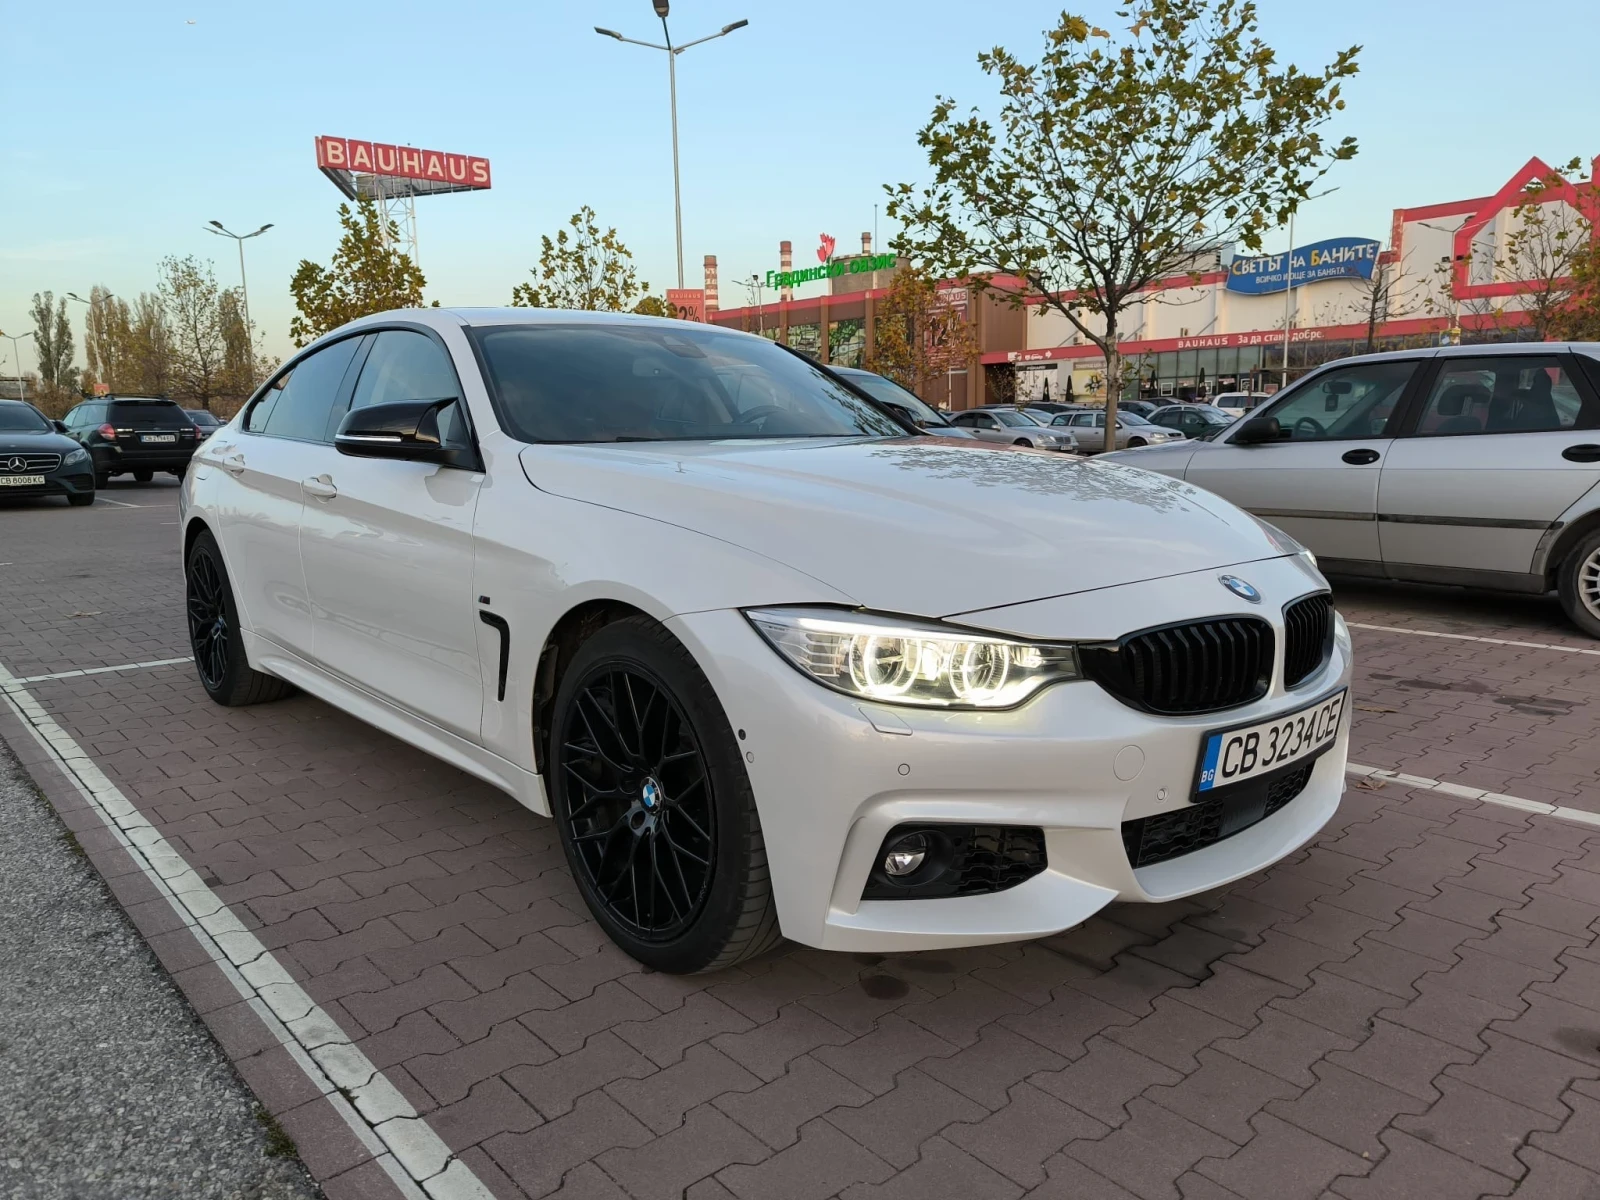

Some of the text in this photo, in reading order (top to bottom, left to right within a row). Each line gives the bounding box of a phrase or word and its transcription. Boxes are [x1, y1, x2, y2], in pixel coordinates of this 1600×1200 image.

[326, 140, 488, 183] BAUHAUS
[766, 253, 897, 291] Градински оазис
[1232, 243, 1374, 276] СВЕТЪТ НА БАНИТЕ
[1255, 273, 1283, 285] ВСИЧКО
[1306, 268, 1317, 279] ЗА
[1317, 267, 1345, 278] БАНЯТА
[1178, 336, 1229, 348] BAUHAUS
[1237, 335, 1248, 344] За
[1249, 334, 1262, 345] да
[1222, 698, 1341, 778] CB 3234 CE
[1201, 768, 1215, 783] BG
